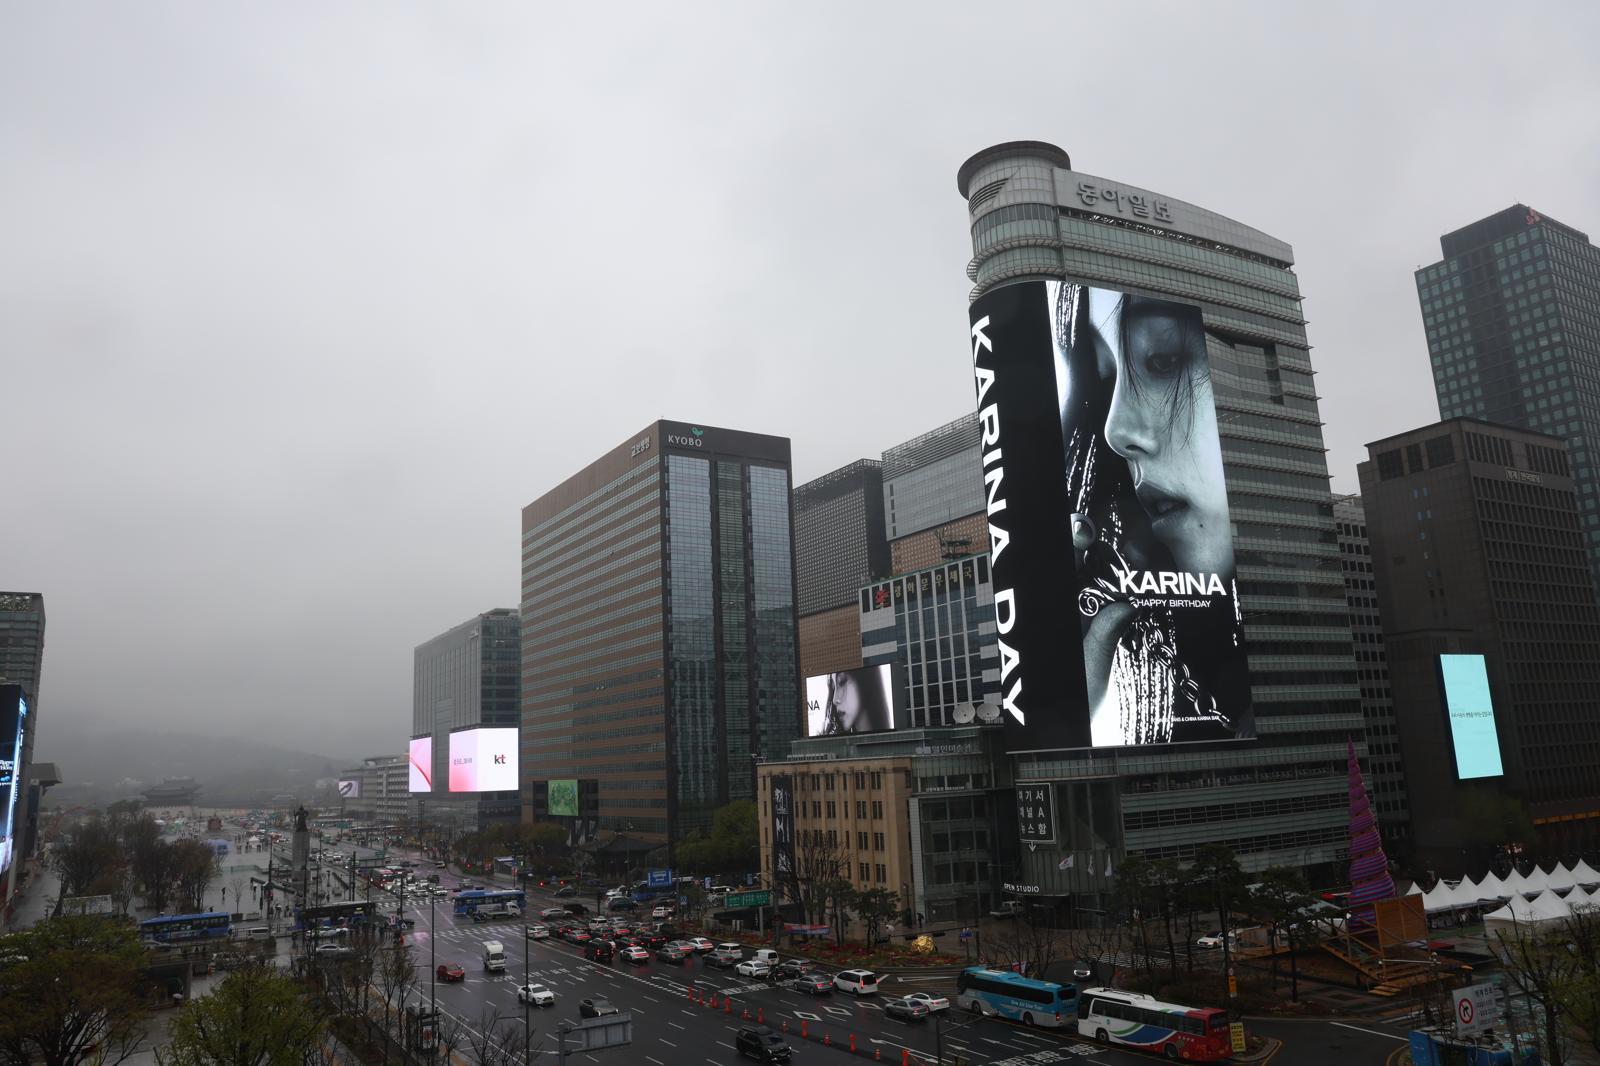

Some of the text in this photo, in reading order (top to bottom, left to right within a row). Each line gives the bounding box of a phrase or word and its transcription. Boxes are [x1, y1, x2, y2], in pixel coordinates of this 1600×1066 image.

[1076, 181, 1174, 223] 동아일보
[668, 434, 703, 448] KYOBO
[971, 314, 1026, 727] KARINA DAY
[1118, 570, 1227, 596] KARINA
[1136, 598, 1211, 608] HAPPY BIRTHDAY
[494, 754, 507, 765] kt
[1016, 885, 1040, 893] STUDIO
